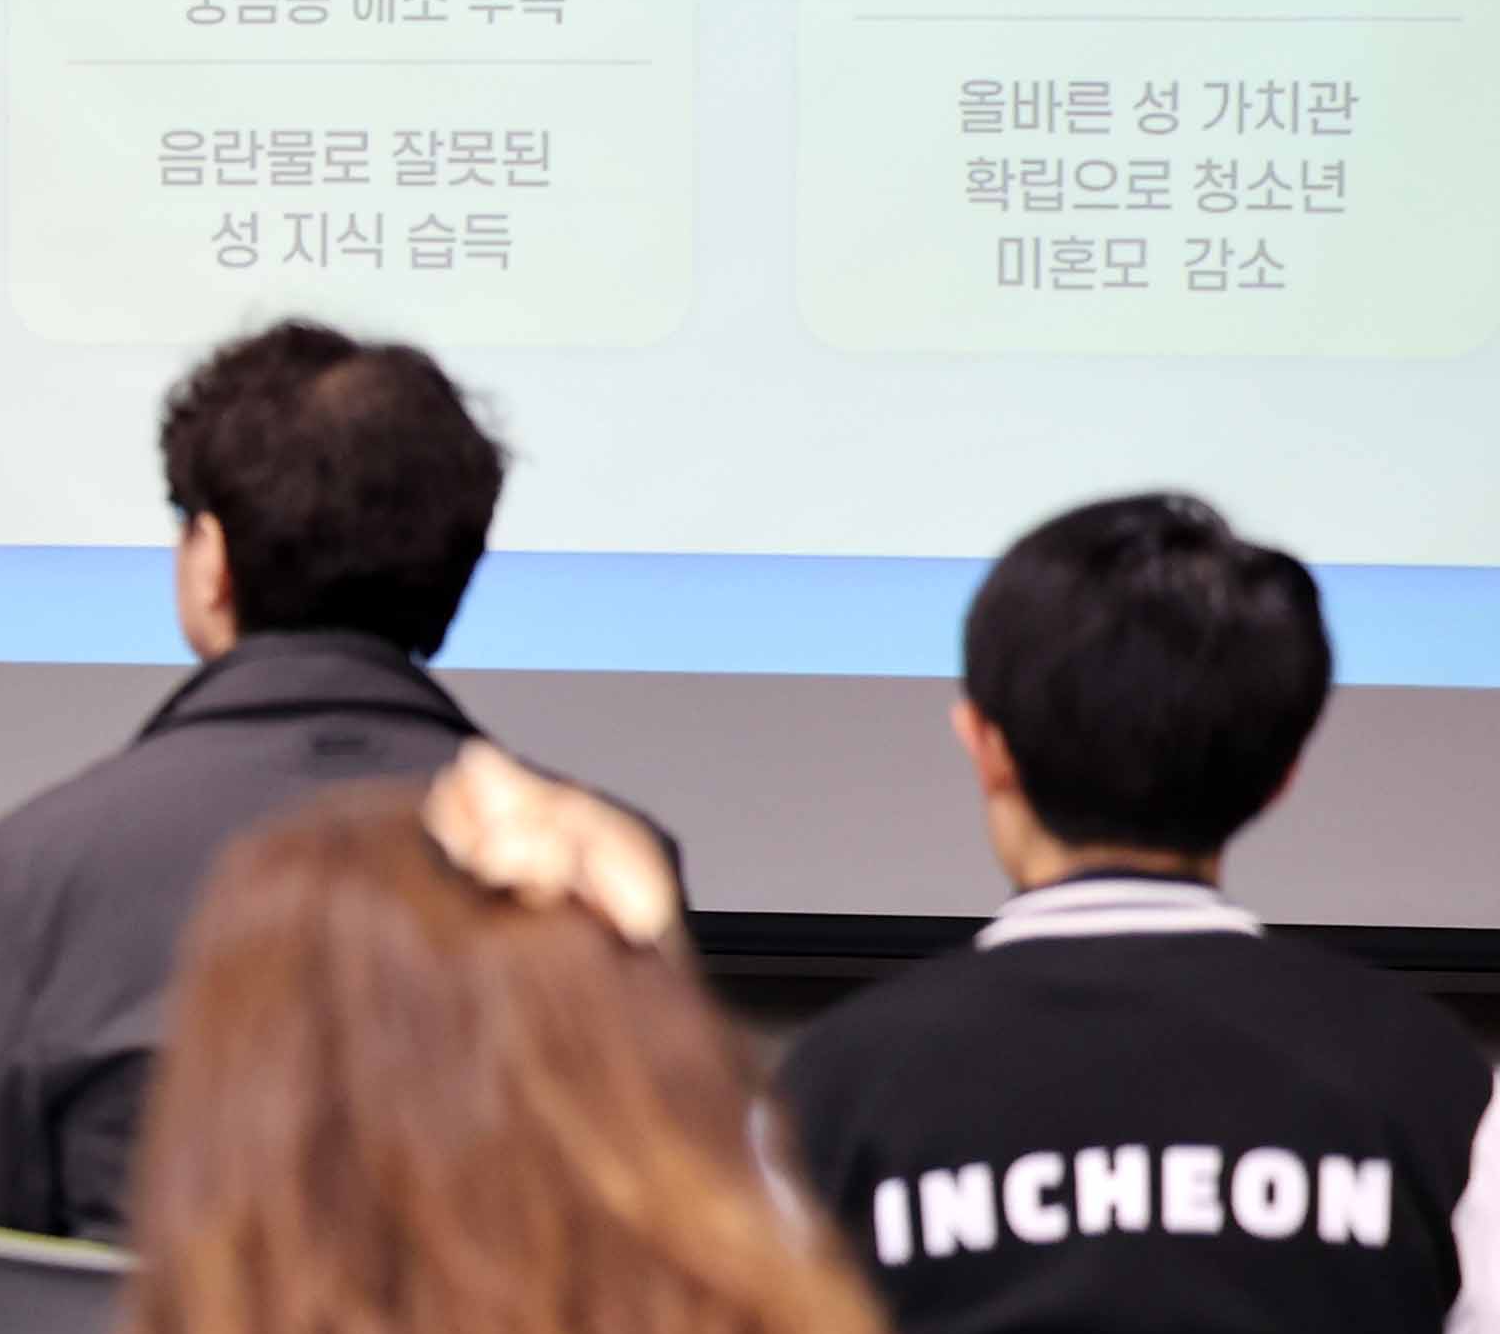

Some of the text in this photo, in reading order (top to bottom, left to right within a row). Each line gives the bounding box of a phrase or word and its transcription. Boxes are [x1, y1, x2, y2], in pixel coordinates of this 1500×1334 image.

[959, 80, 1359, 135] 올바른 성 가치관
[159, 130, 549, 187] 음란물로 잘못된
[966, 157, 1345, 214] 확립으로 청소년
[212, 212, 512, 270] 성 지식 습득
[998, 235, 1285, 291] 미혼모 감소
[874, 1143, 1393, 1266] INCHEON
